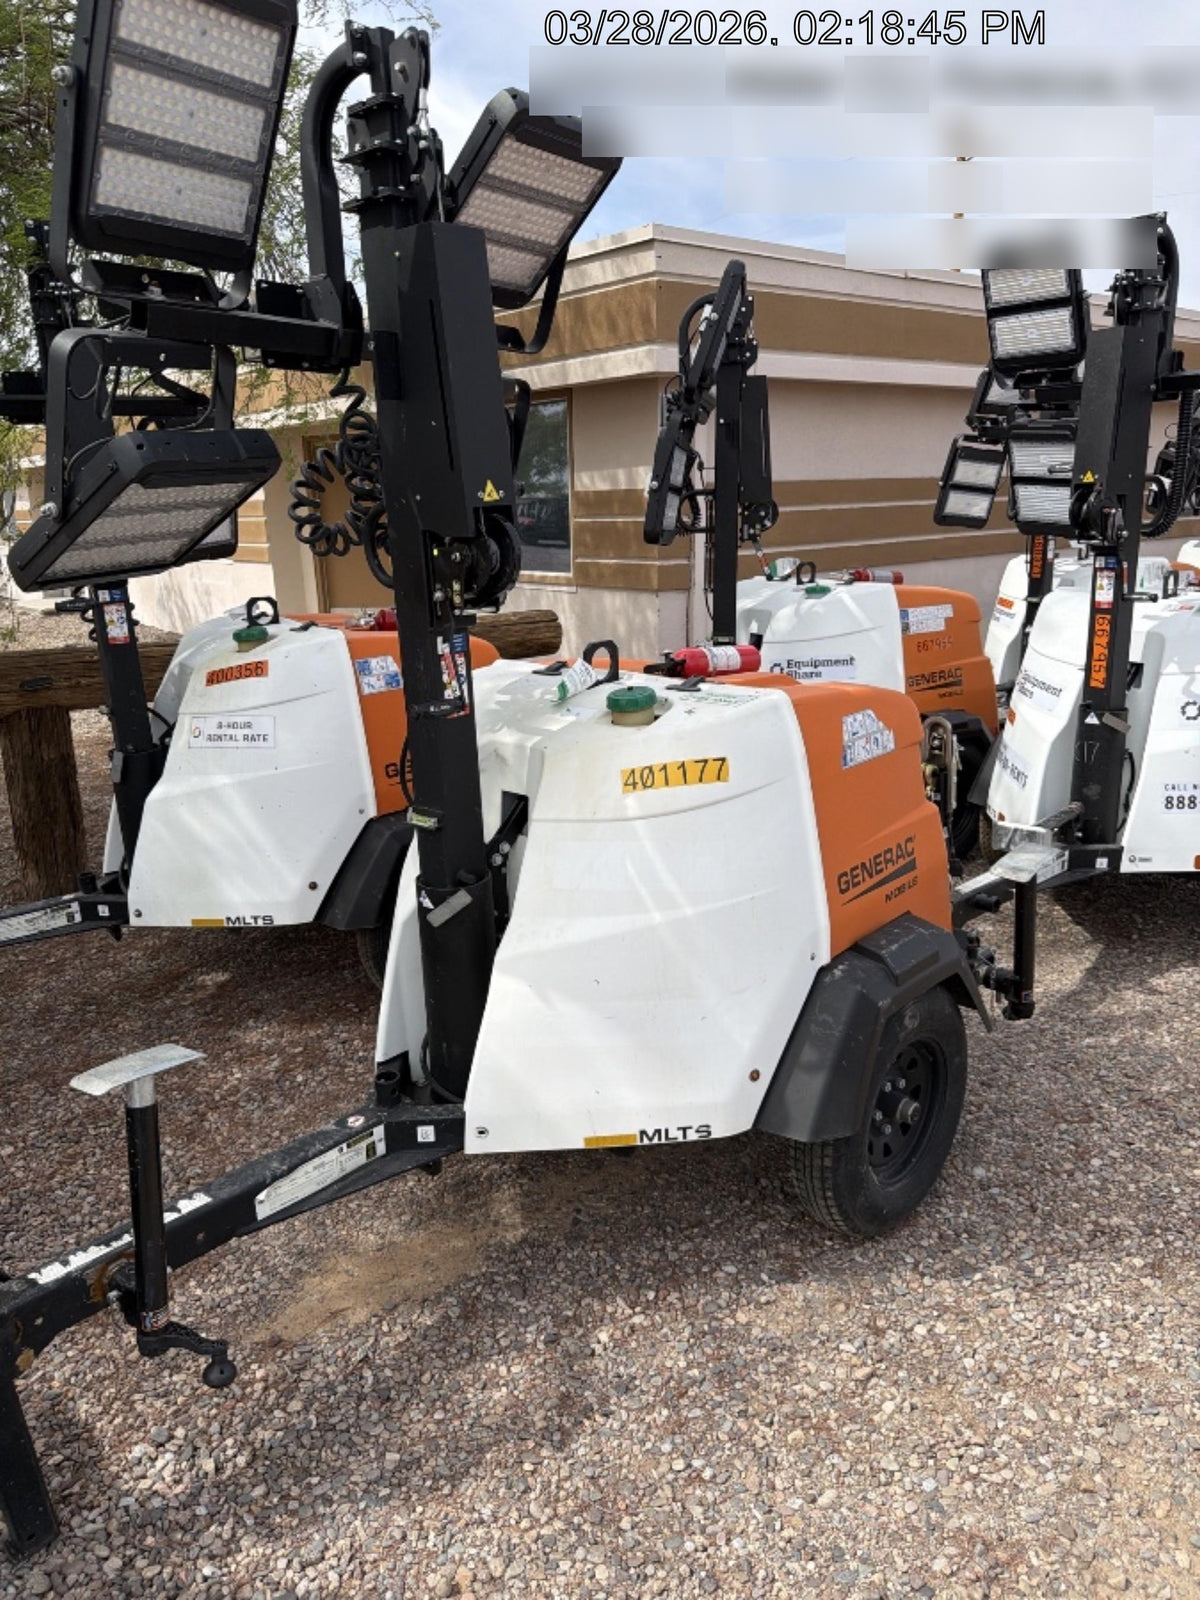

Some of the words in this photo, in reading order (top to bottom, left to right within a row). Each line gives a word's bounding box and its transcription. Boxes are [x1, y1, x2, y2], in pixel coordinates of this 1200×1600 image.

[1091, 616, 1110, 685] 667957
[786, 655, 855, 670] Equipment
[206, 661, 264, 686] 400356
[908, 668, 962, 687] GENERAC
[216, 721, 253, 730] 8-HOUR
[243, 733, 269, 743] RATE
[623, 757, 727, 790] 401177
[1164, 783, 1187, 791] CALL
[837, 836, 915, 894] GENERAC
[225, 915, 274, 926] MLTS
[639, 1125, 712, 1143] MLTS
